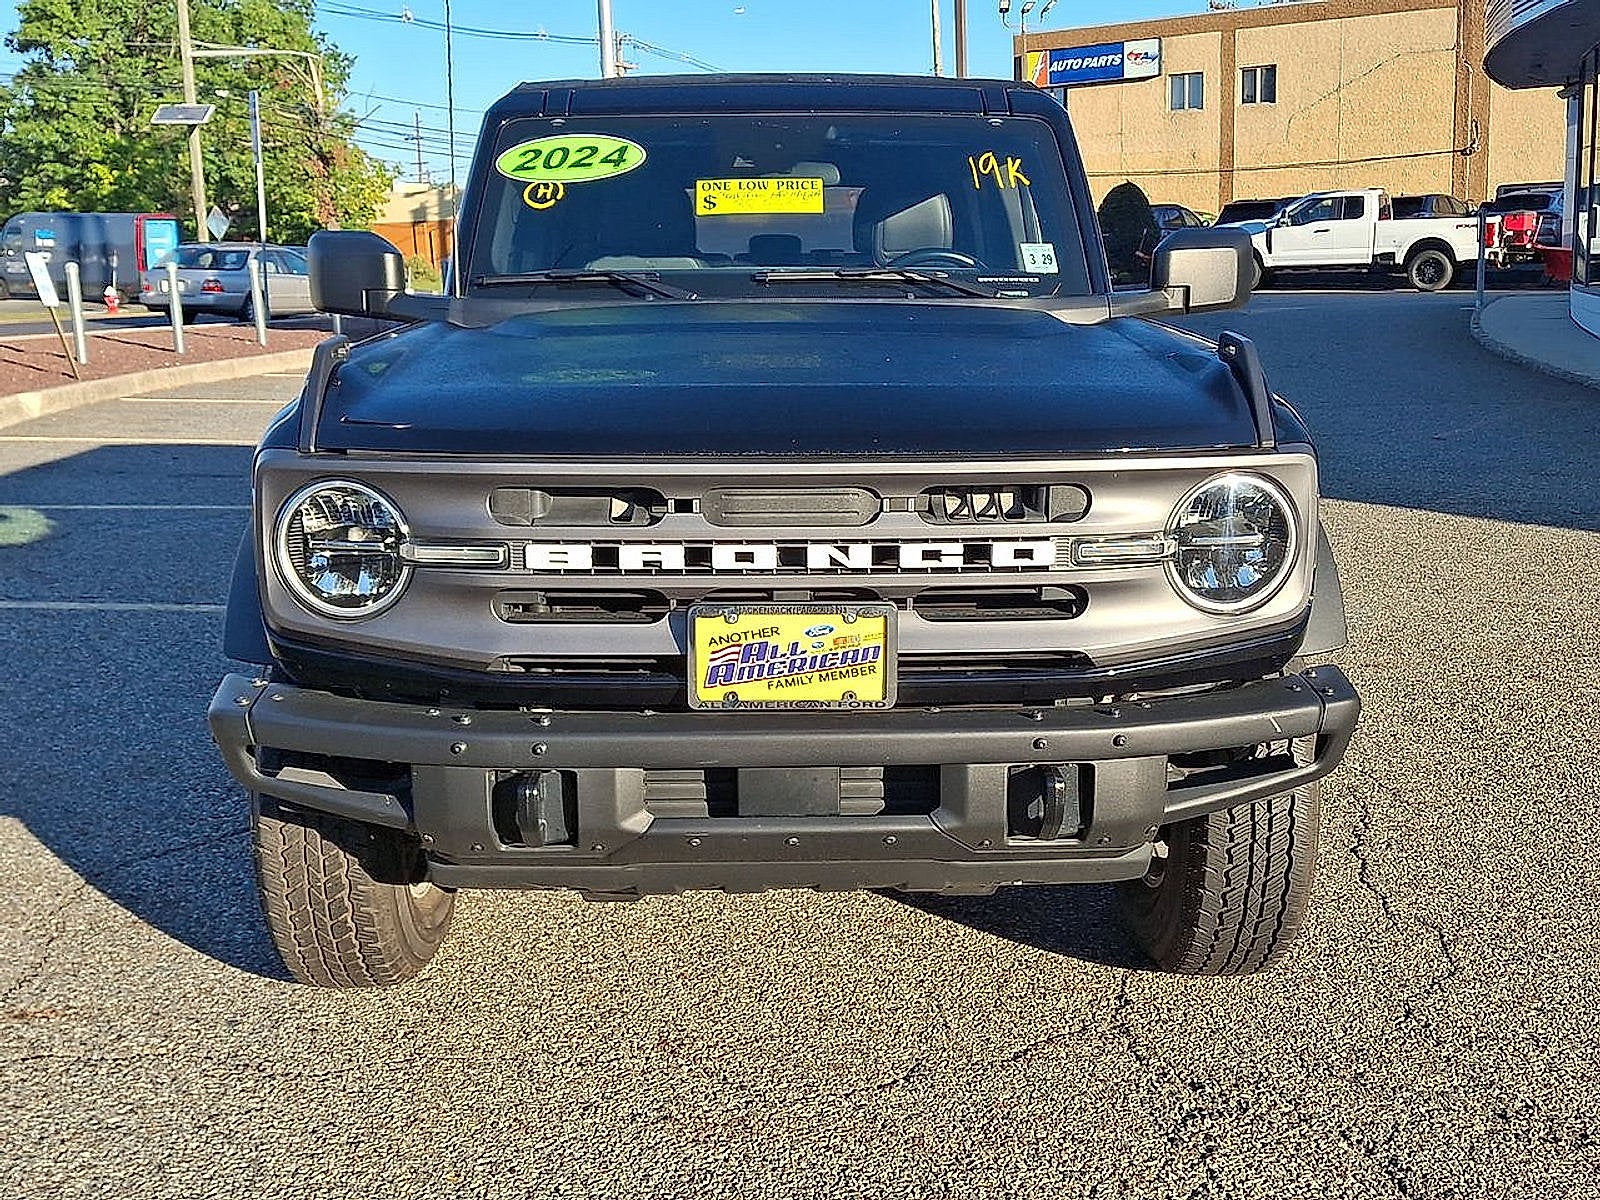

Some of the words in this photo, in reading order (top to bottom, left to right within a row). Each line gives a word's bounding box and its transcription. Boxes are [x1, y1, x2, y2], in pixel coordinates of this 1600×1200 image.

[1049, 58, 1082, 72] AUTO
[1082, 53, 1122, 69] PARTS
[510, 145, 629, 173] 2024
[701, 181, 731, 192] ONE
[738, 180, 769, 190] LOW
[776, 180, 819, 190] PRICE
[702, 194, 717, 210] $
[1029, 253, 1037, 265] 3
[1041, 253, 1053, 265] 29
[525, 541, 1056, 570] BRONCO
[708, 626, 780, 647] ANOTHER
[741, 641, 808, 664] ALL
[707, 645, 881, 686] AMERICAN
[767, 674, 814, 690] FAMILY
[819, 665, 877, 683] MEMBER
[736, 700, 831, 709] AMERICAN
[837, 700, 887, 709] FORD
